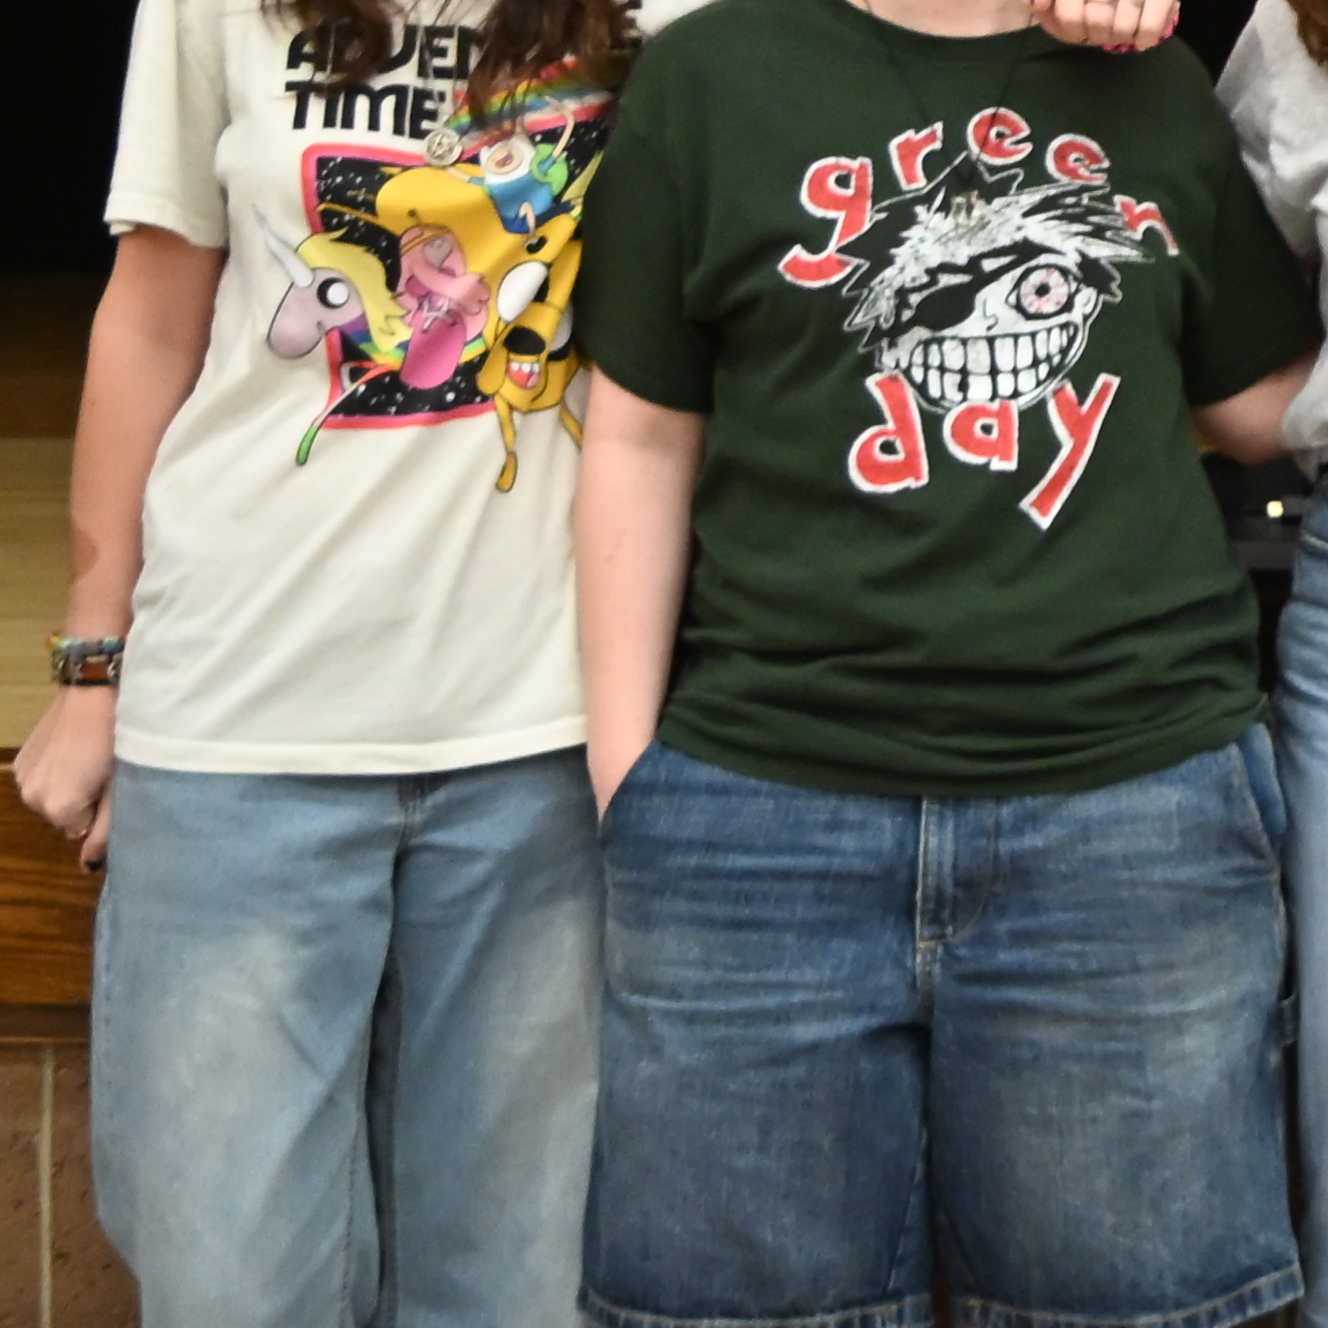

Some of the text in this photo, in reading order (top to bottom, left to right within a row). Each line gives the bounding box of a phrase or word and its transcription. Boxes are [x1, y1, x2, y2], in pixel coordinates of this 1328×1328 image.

[285, 80, 448, 139] TIME
[778, 106, 1179, 289] green
[848, 372, 1121, 530] day
